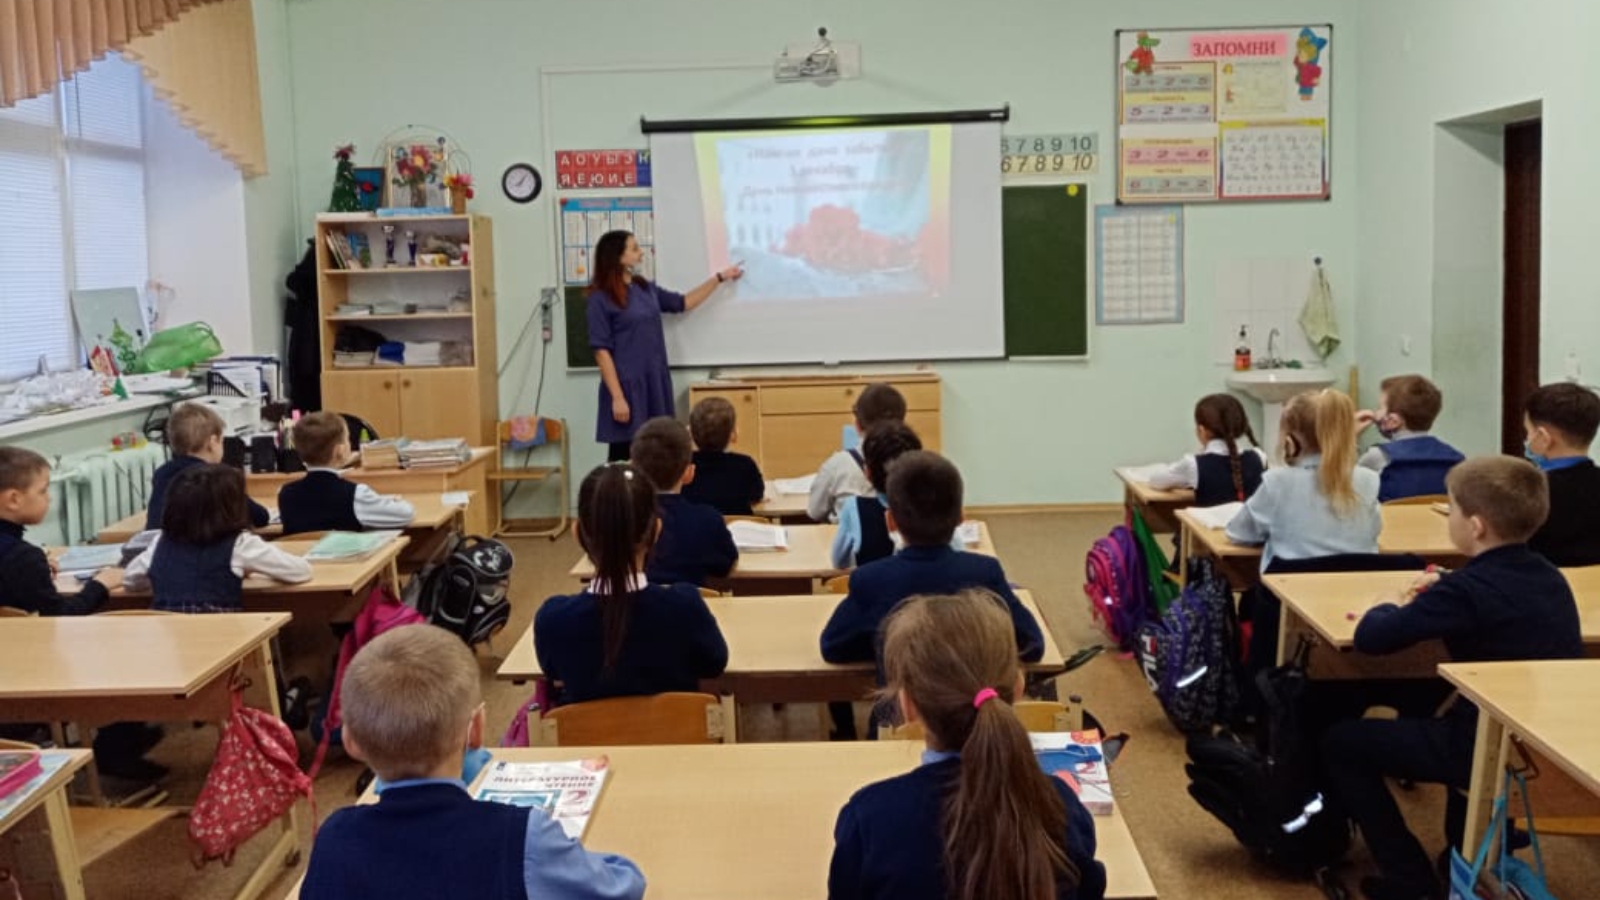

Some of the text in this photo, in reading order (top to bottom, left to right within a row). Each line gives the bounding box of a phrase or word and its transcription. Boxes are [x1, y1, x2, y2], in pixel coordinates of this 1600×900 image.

[1193, 40, 1276, 56] ЗАПОМНИ
[1016, 138, 1026, 152] 7
[1034, 137, 1045, 152] 8
[1051, 137, 1062, 151] 9
[1070, 136, 1091, 151] 10
[1001, 153, 1093, 173] 6 7 8 9 10
[1140, 633, 1159, 691] FILA
[562, 789, 587, 805] 2
